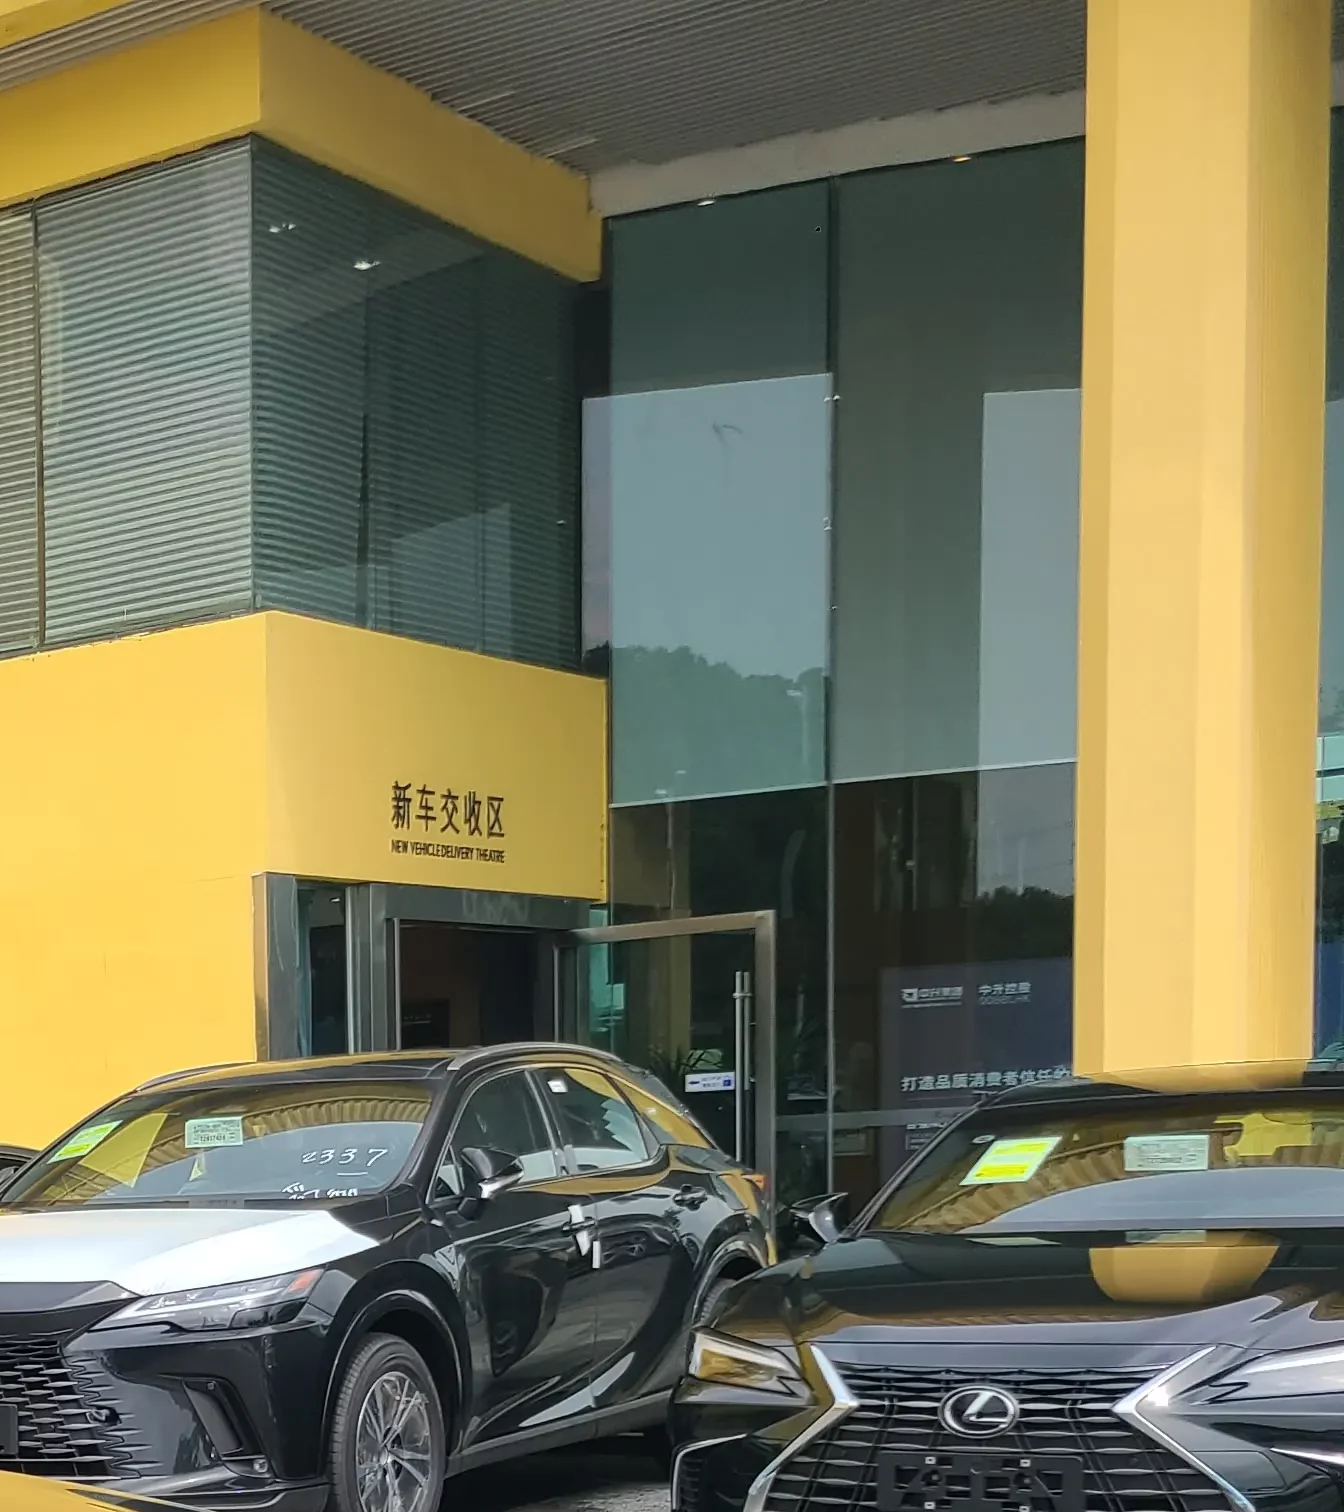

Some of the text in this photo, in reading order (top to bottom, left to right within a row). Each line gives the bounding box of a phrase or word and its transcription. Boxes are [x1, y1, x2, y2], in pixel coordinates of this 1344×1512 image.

[391, 780, 505, 839] 新车交收区
[391, 839, 505, 863] NEW VEHICLE DELIVERY THEATRE
[302, 1148, 389, 1167] 2337
